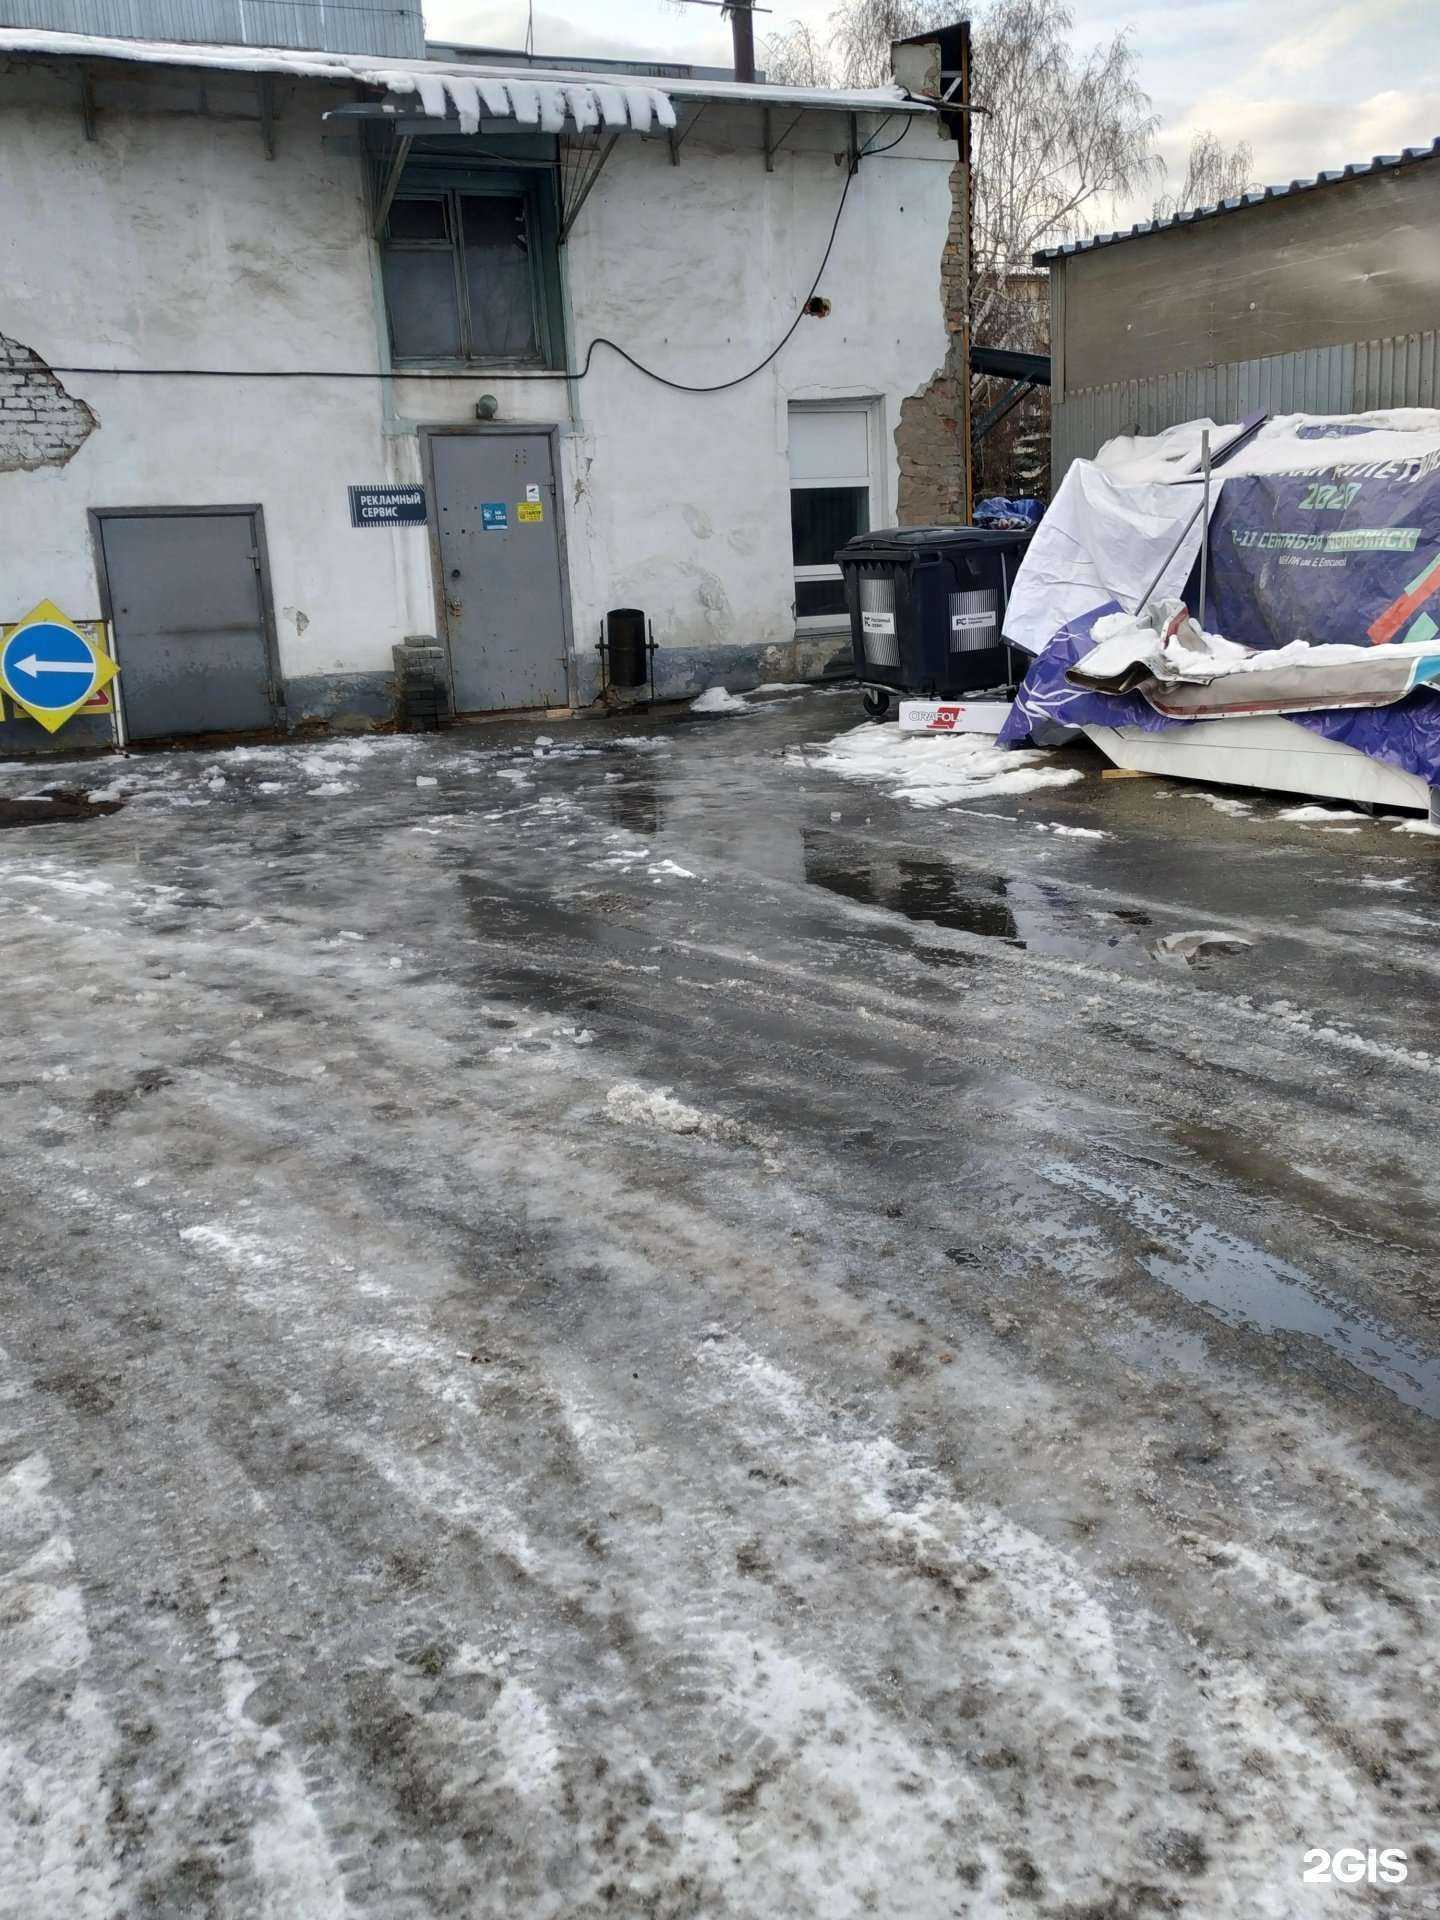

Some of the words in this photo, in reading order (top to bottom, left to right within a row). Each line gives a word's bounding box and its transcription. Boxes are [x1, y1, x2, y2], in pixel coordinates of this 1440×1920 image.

[360, 492, 421, 506] РЕКЛАМНЫЙ
[361, 506, 398, 518] СЕРВИС
[908, 710, 963, 722] ORAFOL
